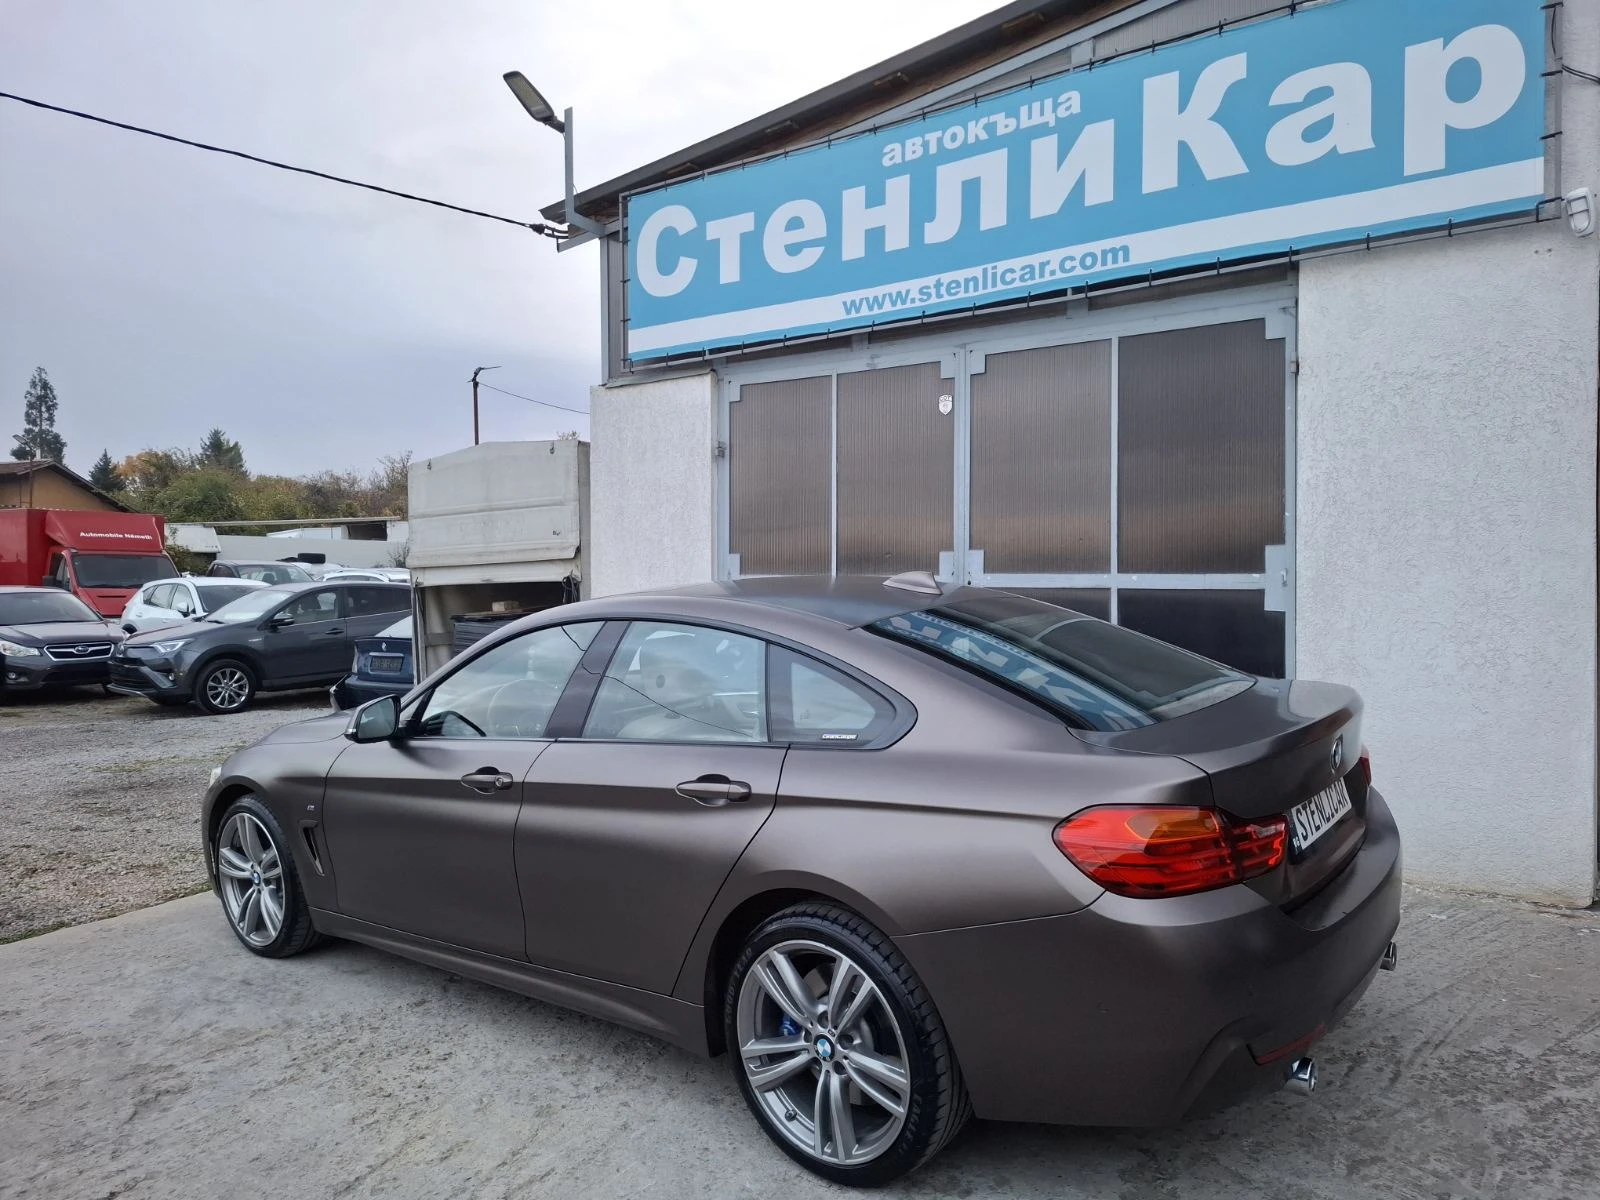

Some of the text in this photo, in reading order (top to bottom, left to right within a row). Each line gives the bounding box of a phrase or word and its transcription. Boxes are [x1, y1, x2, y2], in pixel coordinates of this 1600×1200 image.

[636, 24, 1526, 297] СтенлиКар
[882, 90, 1081, 167] автокъща
[842, 241, 1130, 315] www.stenlicar.com
[1296, 780, 1349, 842] STENLICAR
